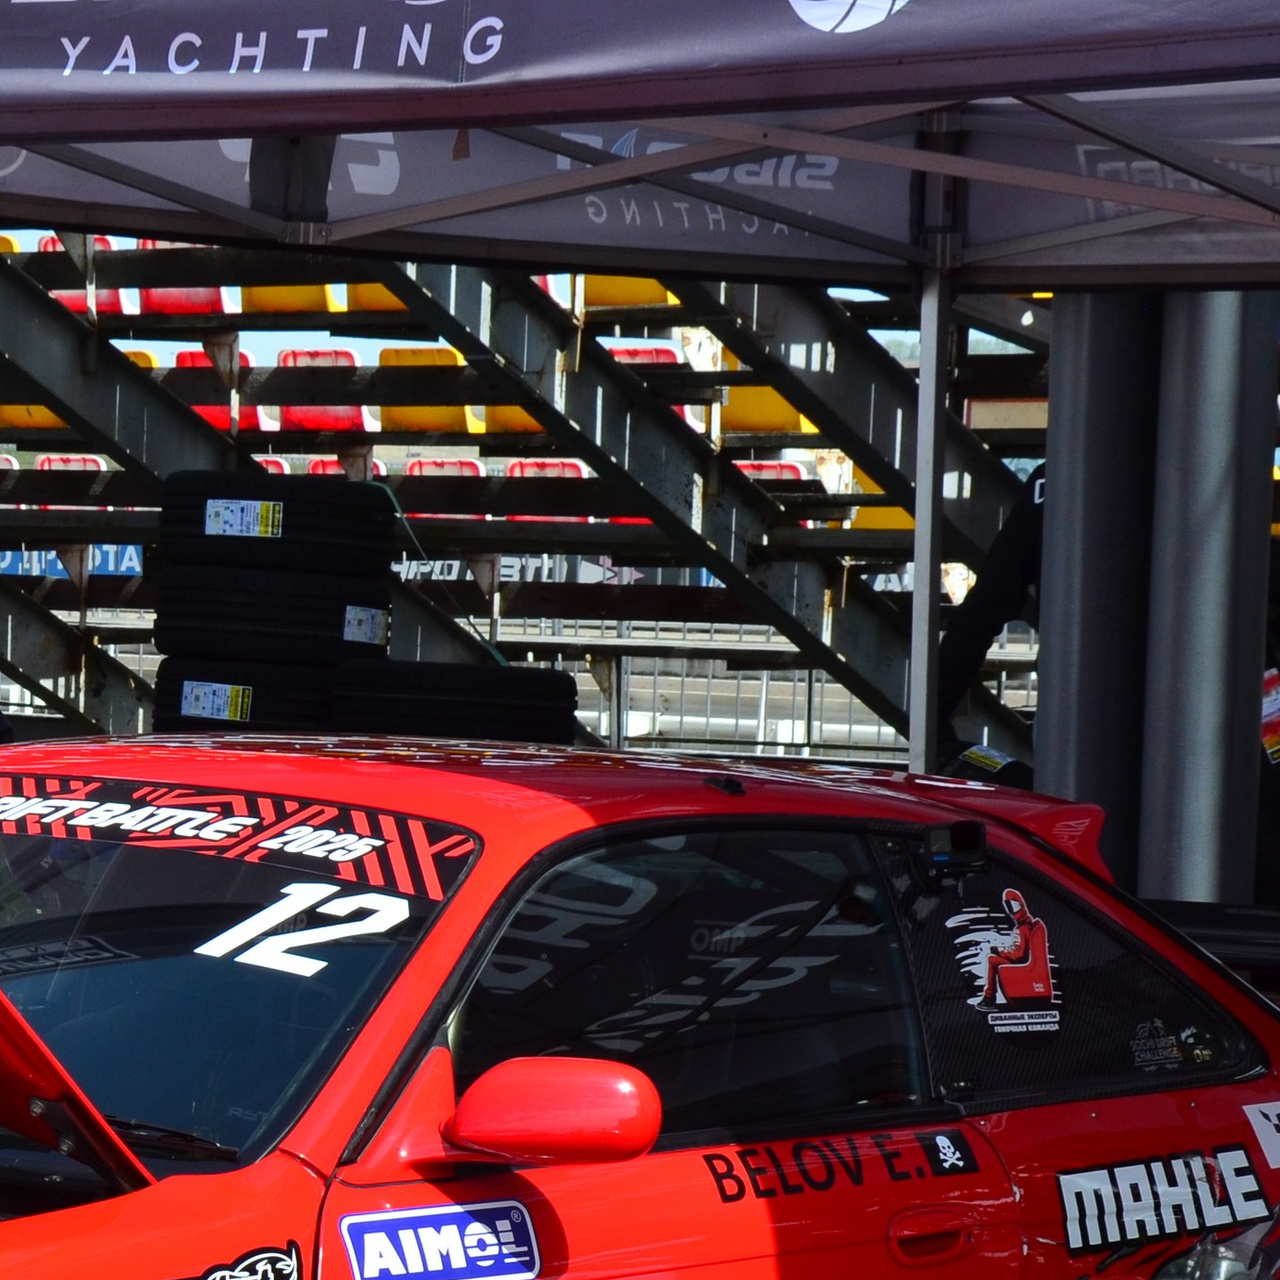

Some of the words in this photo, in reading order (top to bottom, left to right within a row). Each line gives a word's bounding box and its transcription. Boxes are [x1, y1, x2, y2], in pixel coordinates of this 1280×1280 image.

[60, 16, 505, 76] YACHTING
[257, 825, 385, 862] 2025
[193, 882, 410, 977] 12
[702, 1135, 865, 1205] BELOV
[1059, 1149, 1270, 1249] MAHLE
[362, 1218, 528, 1279] AIMOL
